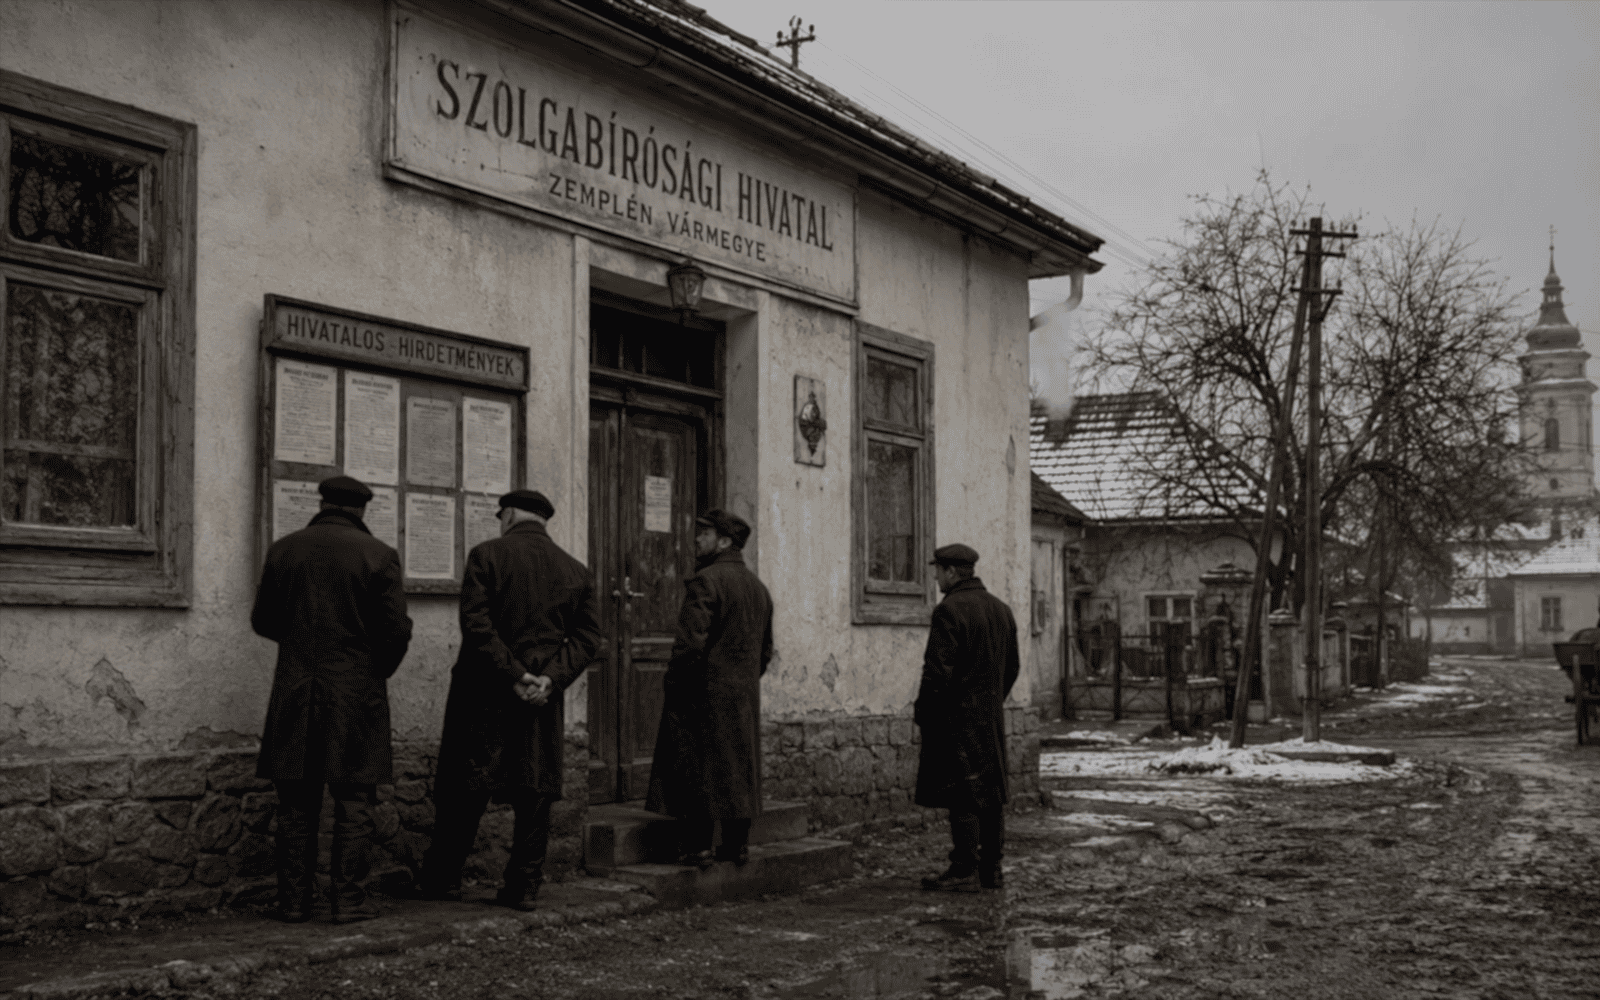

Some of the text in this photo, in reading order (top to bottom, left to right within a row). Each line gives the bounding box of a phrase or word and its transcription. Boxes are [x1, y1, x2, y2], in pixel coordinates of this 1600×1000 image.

[437, 59, 833, 251] SZOLGABÍRÓSÁGI HIVATAL
[549, 173, 767, 262] ZEMPLÉN VÁRMEGYE
[287, 314, 514, 377] HIVATALOS HIRDETMÉNYEK
